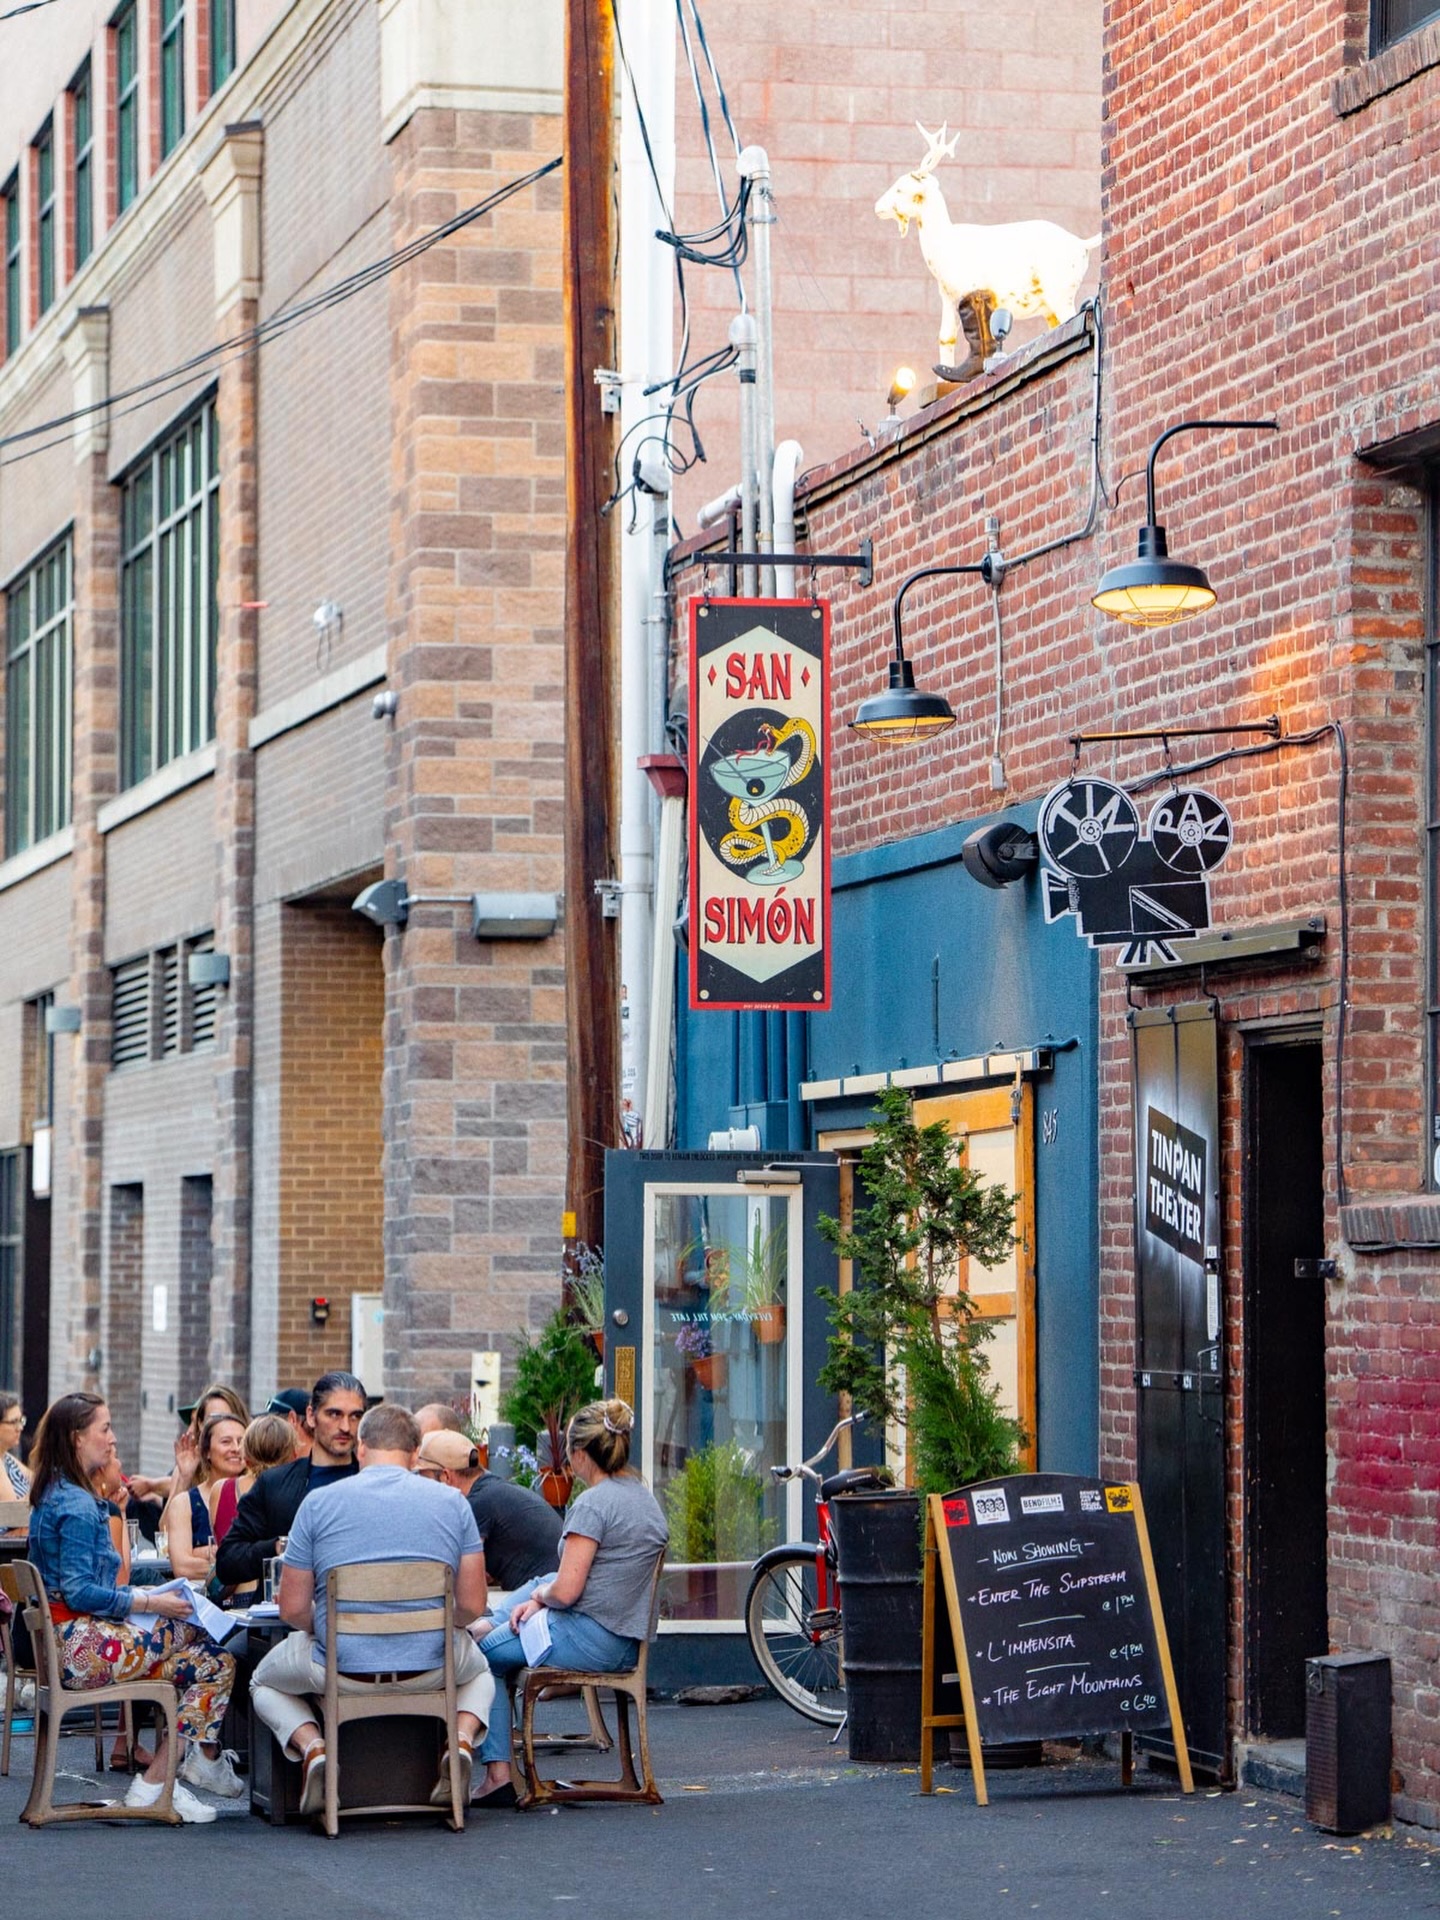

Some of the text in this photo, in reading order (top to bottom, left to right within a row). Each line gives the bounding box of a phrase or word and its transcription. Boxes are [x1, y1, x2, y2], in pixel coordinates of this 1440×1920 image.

[726, 652, 792, 700] SAN
[1154, 794, 1229, 842] PAN
[704, 887, 816, 945] SIMÓN
[1151, 1129, 1202, 1195] TINPAN
[1150, 1176, 1201, 1245] THEATER
[1022, 1538, 1083, 1560] SHOWING
[993, 1686, 1020, 1706] THE
